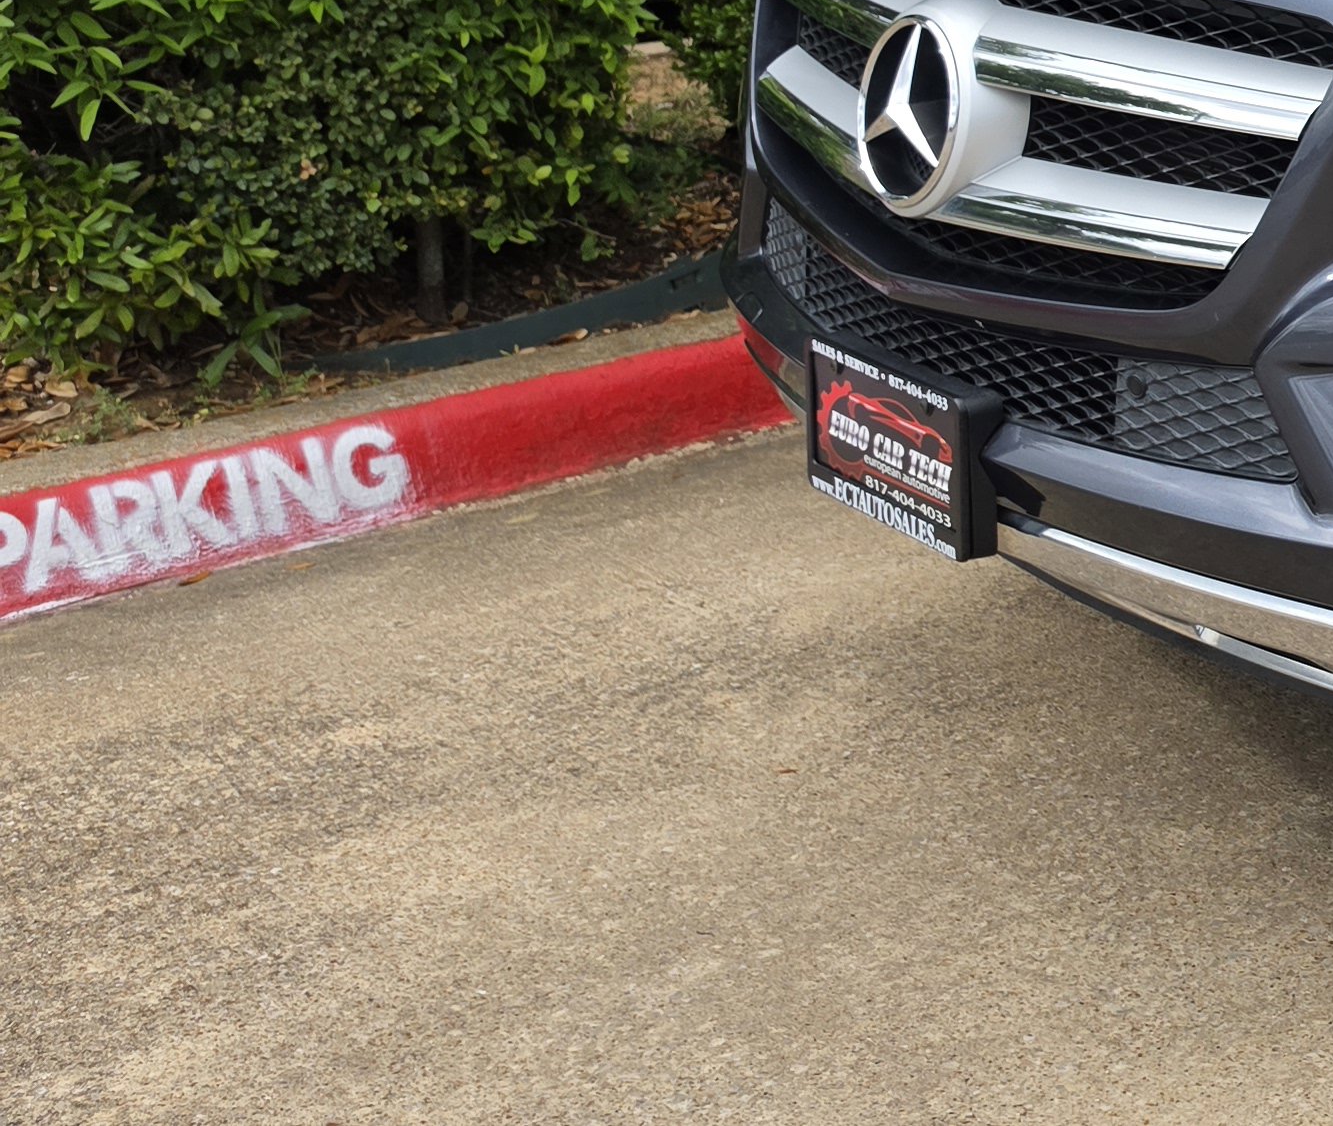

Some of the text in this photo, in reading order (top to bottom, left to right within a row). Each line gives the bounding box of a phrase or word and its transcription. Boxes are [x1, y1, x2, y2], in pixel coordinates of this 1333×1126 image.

[812, 338, 949, 412] SALES & SERVICE 817-404-4033
[828, 410, 953, 492] EURO CAR TECH
[863, 454, 951, 504] european automotive
[811, 475, 957, 560] www.ECTAUTOSALES.com
[865, 475, 952, 528] 817-404-4033
